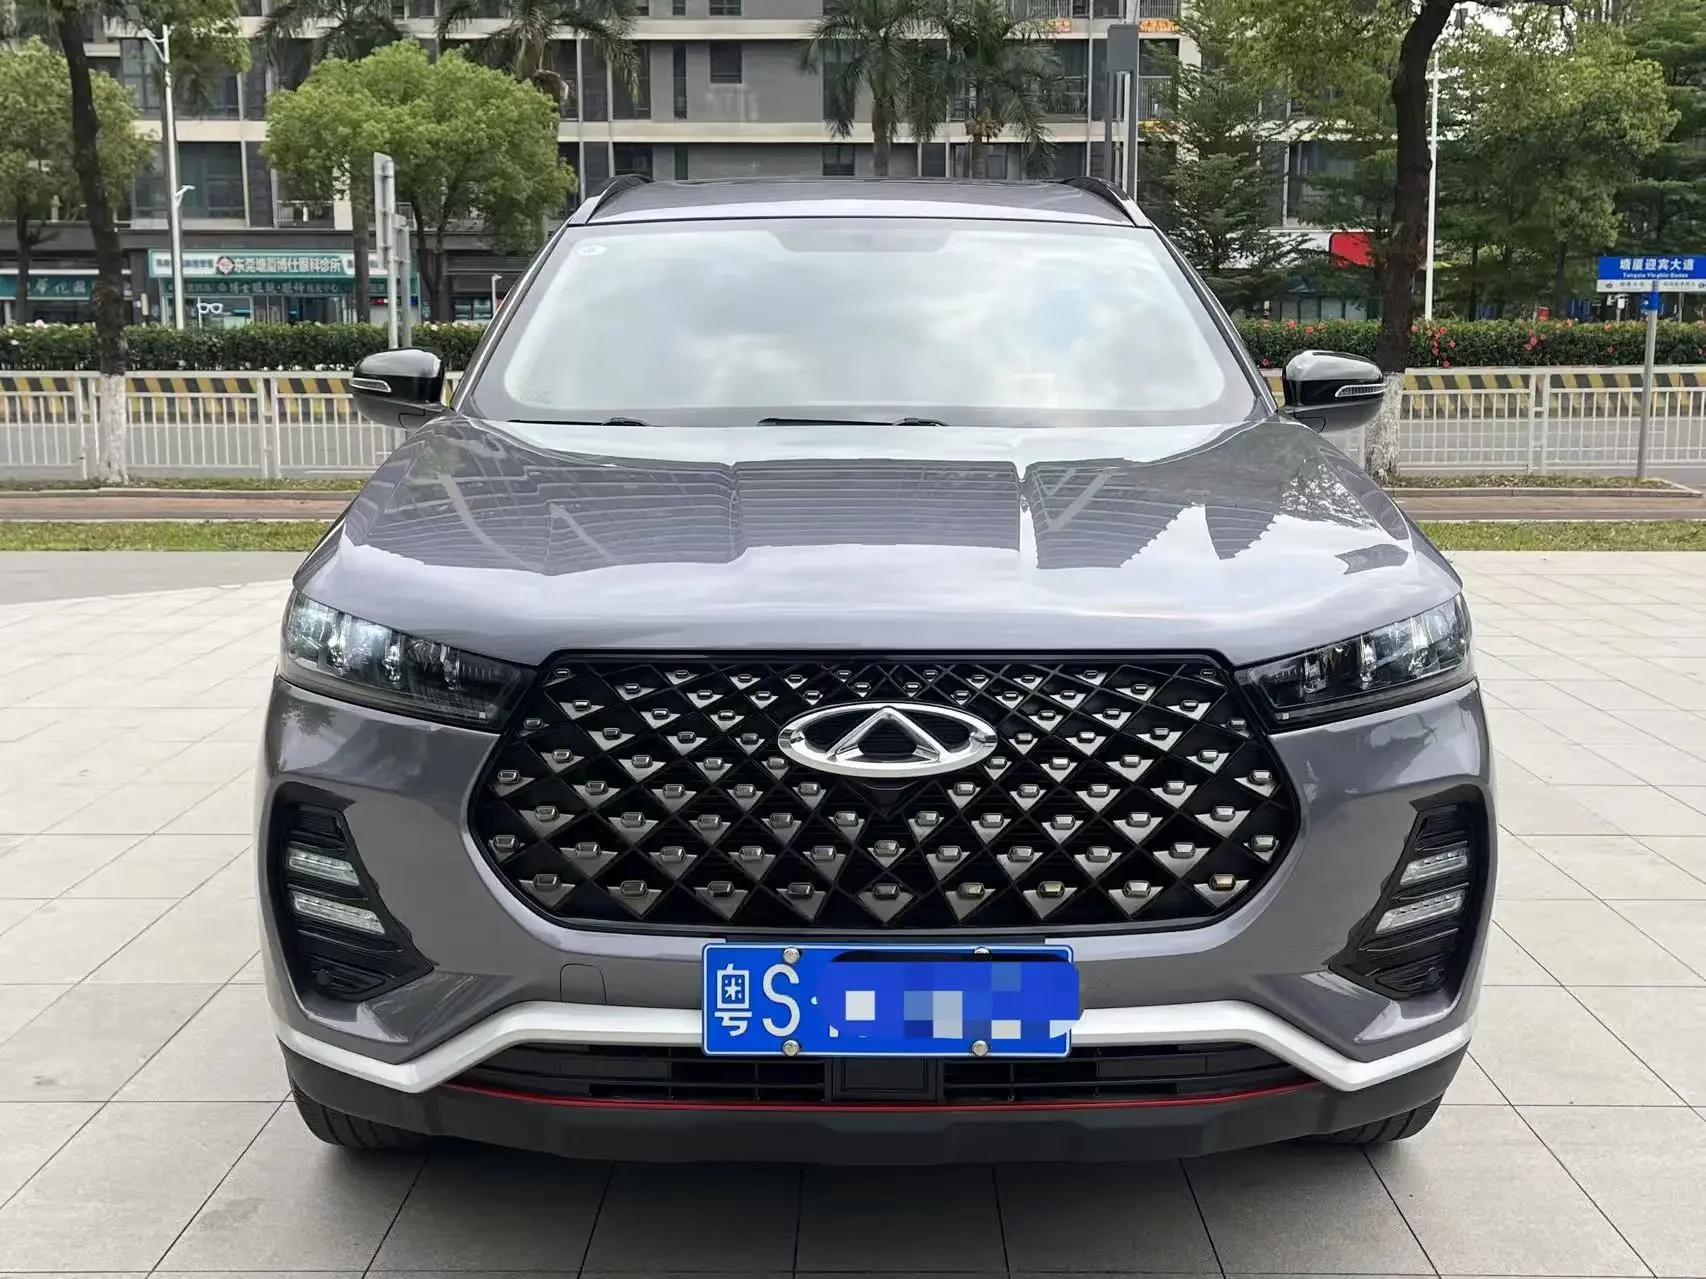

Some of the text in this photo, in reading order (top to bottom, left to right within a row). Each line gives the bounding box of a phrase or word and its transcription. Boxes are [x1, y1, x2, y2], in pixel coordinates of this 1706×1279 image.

[1619, 258, 1695, 271] 塘厦迎宾大道
